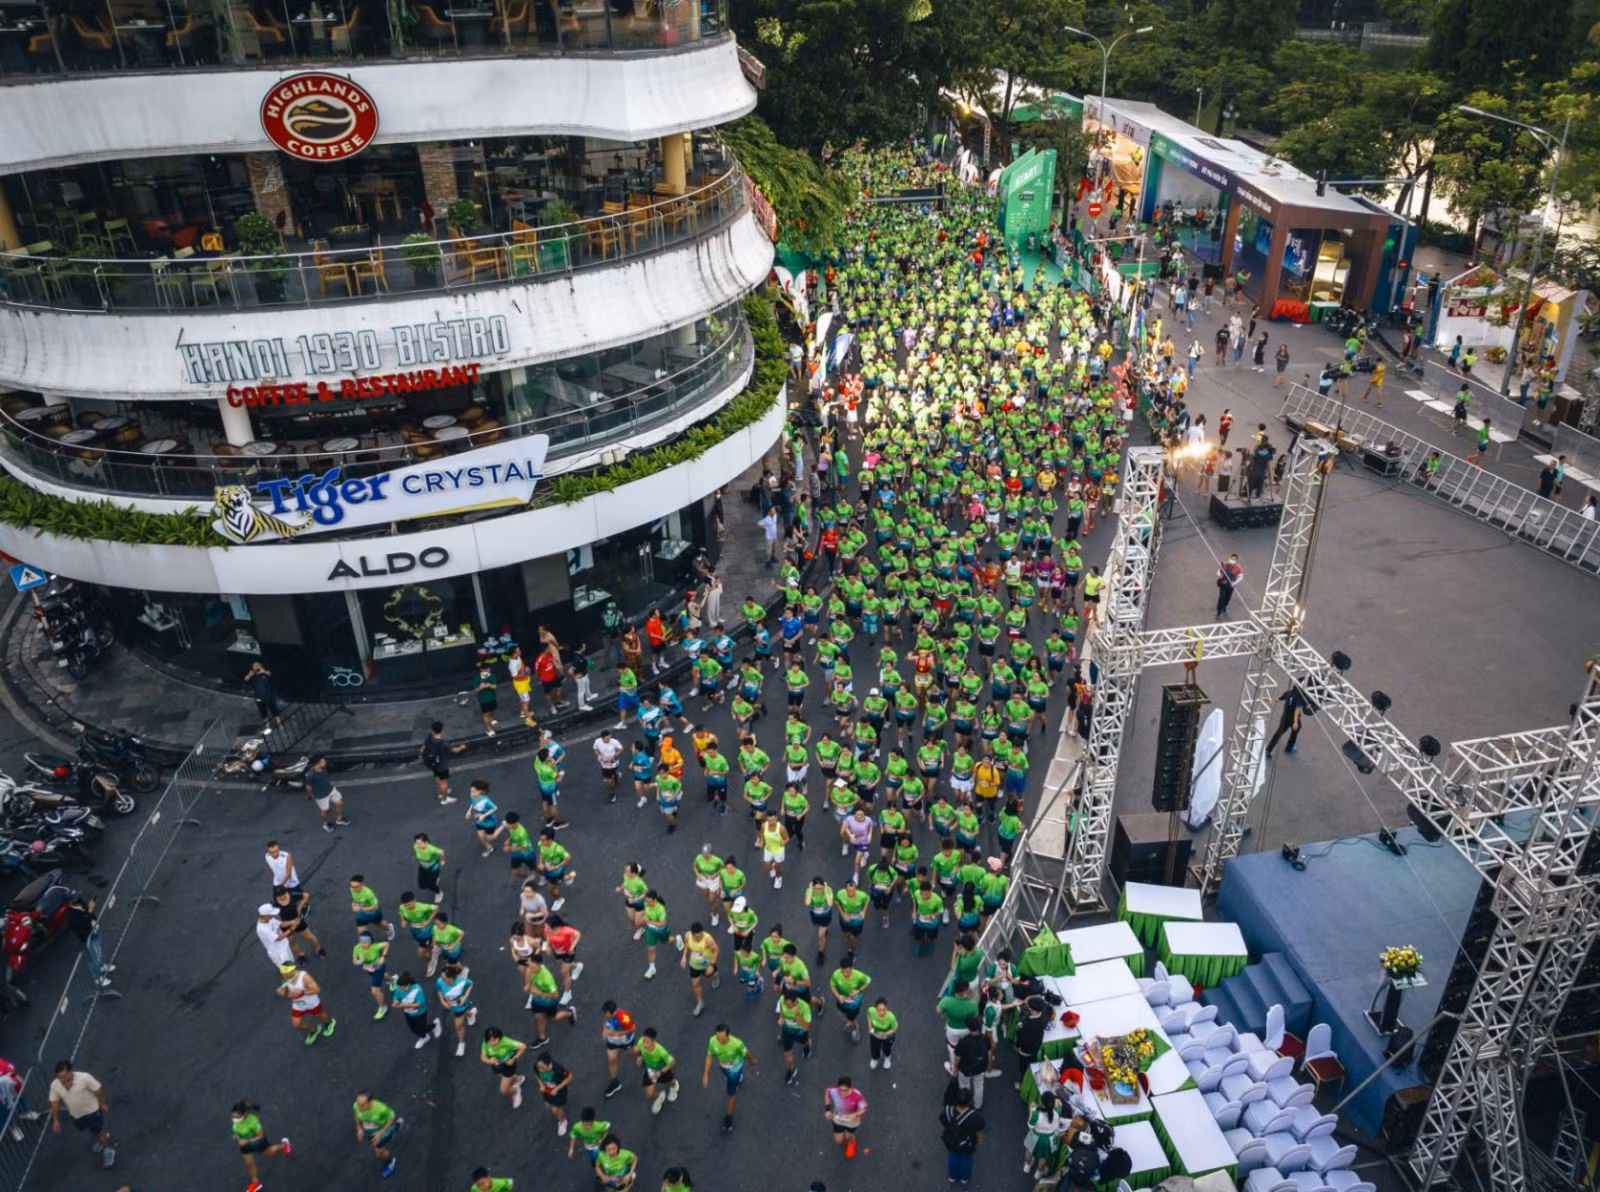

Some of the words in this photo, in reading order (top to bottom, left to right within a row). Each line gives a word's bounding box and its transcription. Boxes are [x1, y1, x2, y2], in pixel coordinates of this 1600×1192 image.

[267, 80, 369, 118] HIGHLANDS
[287, 134, 364, 157] COFFEE
[181, 337, 292, 384] HANOI
[296, 329, 381, 376] 1930
[391, 314, 511, 367] BISTRO
[226, 382, 311, 408] COFFEE
[317, 381, 336, 401] &
[340, 363, 480, 399] RESTAURANT
[256, 466, 391, 525] Tiger
[402, 460, 544, 495] CRYSTAL
[327, 546, 449, 580] ALDO
